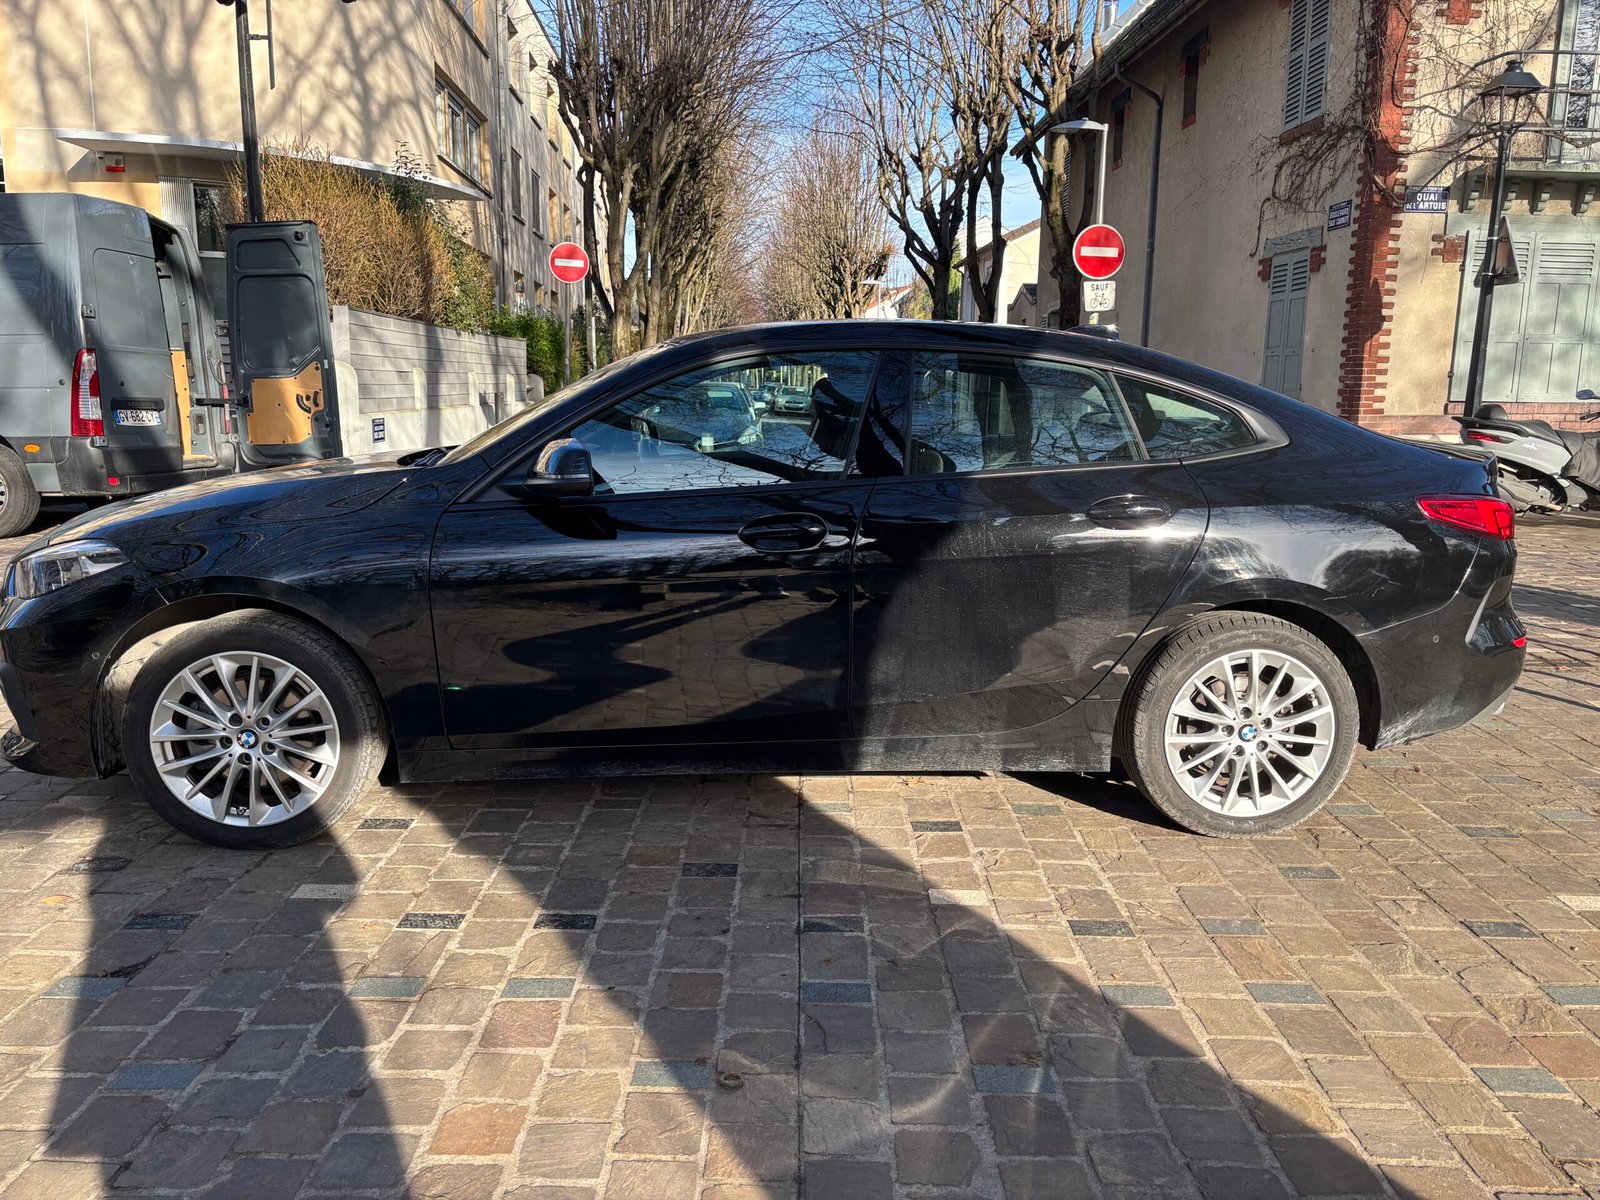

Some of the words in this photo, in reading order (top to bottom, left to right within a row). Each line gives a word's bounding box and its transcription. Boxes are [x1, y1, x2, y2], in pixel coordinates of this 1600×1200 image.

[1416, 193, 1438, 202] QUAI
[1413, 201, 1447, 210] L'ARTOIS
[1090, 283, 1109, 291] SAUF
